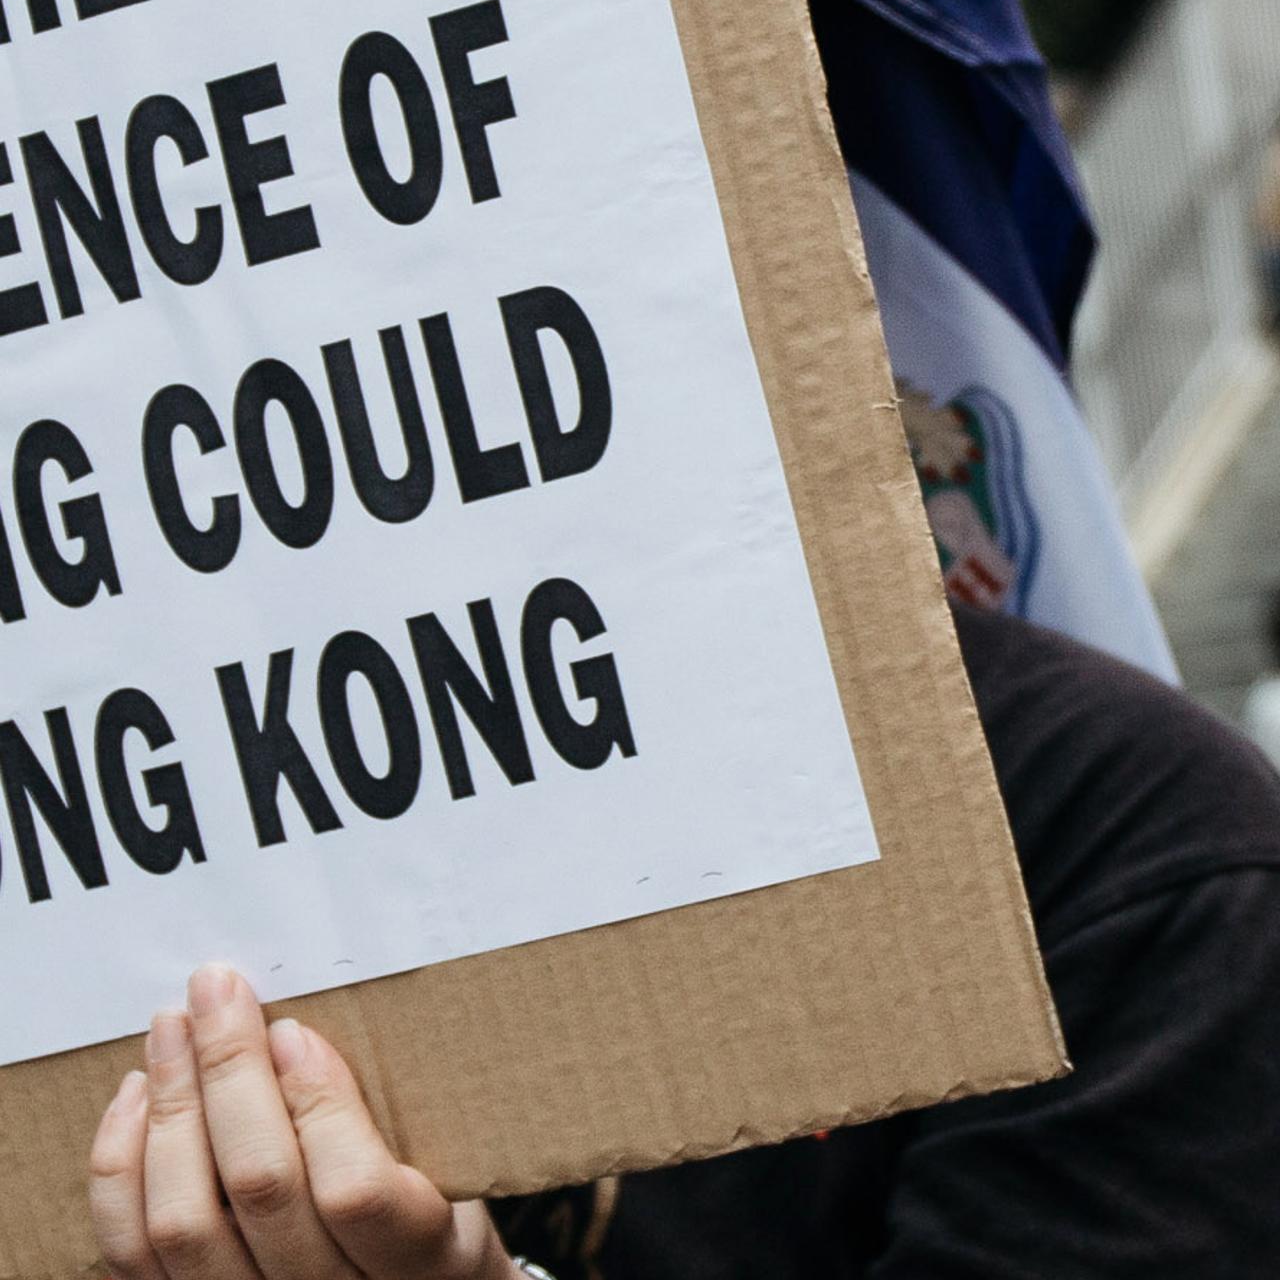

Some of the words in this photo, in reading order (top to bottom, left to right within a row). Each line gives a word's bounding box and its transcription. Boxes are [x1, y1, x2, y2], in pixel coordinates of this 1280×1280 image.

[0, 419, 123, 624] G
[142, 286, 613, 574] COULD
[0, 687, 208, 904] NG
[214, 578, 638, 849] KONG
